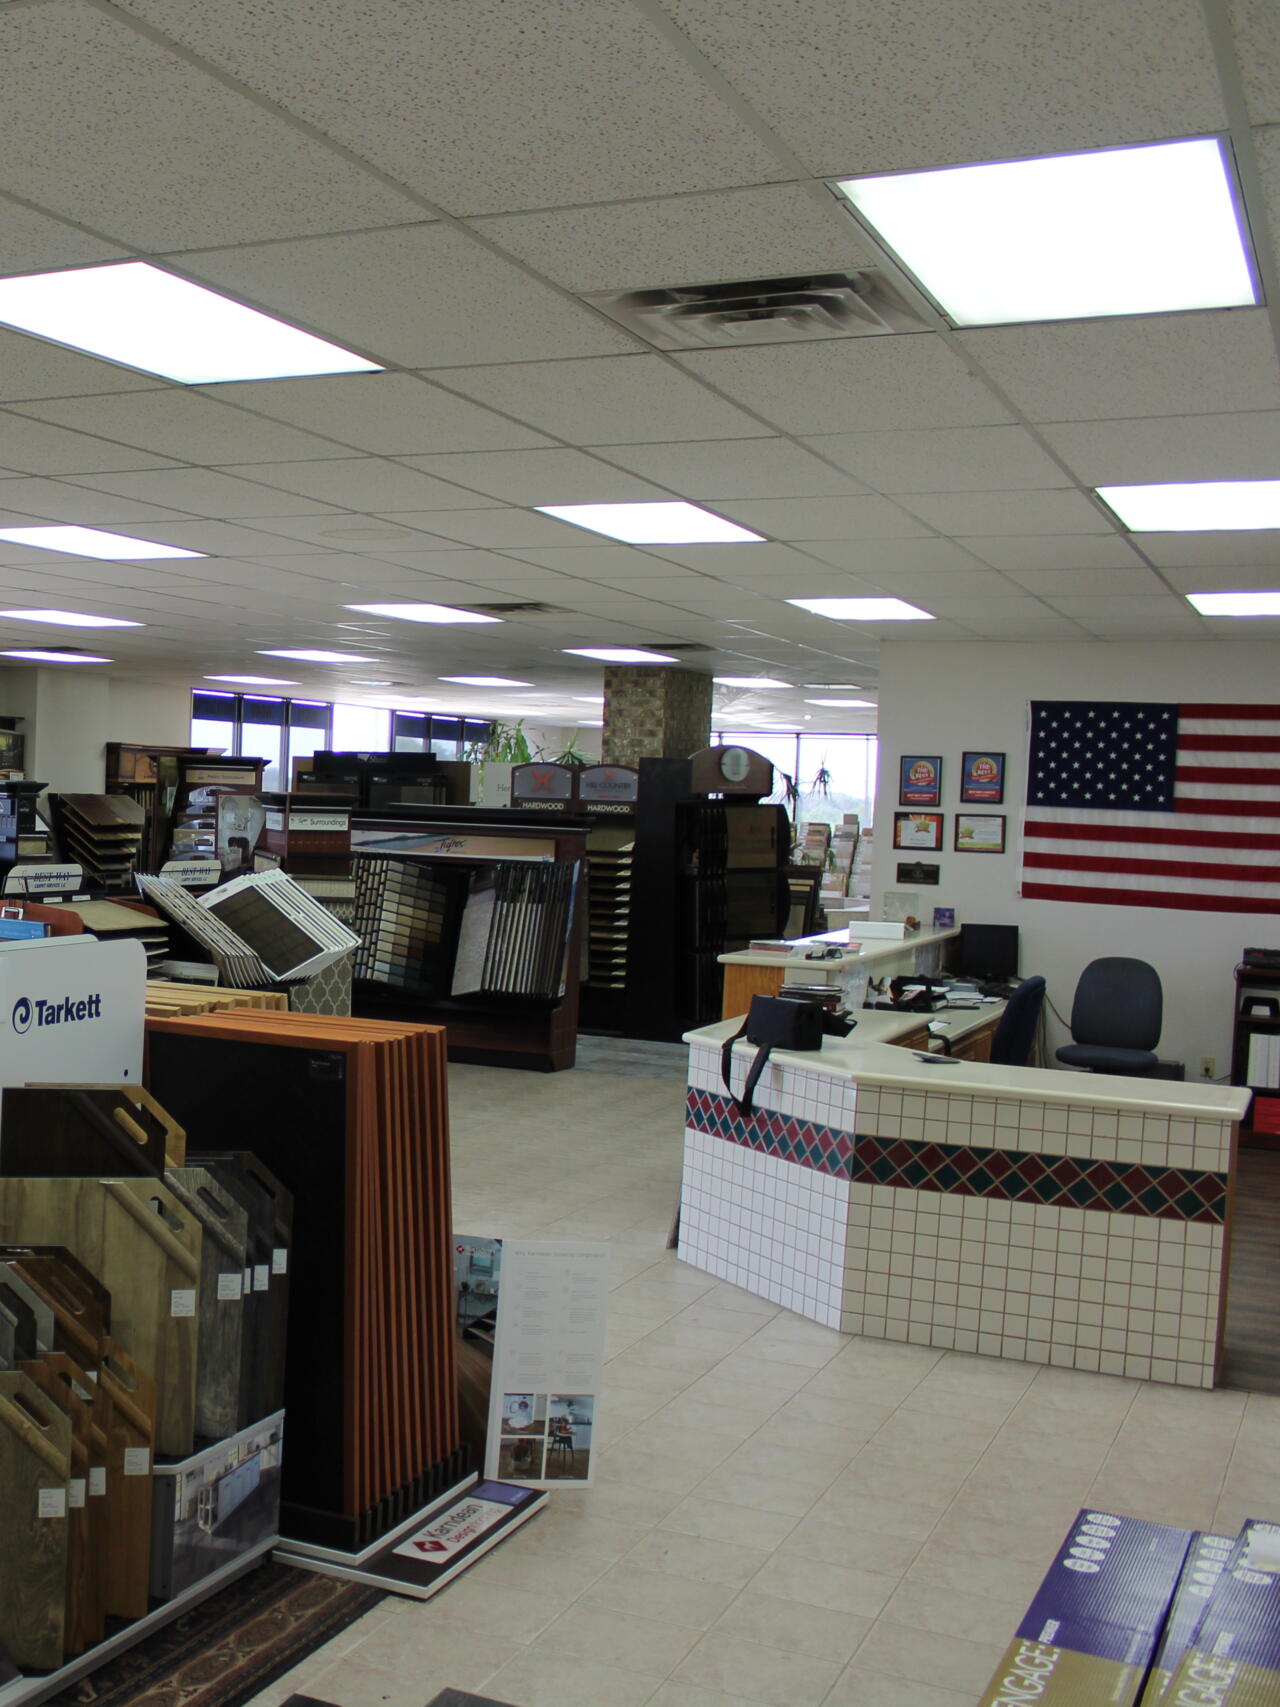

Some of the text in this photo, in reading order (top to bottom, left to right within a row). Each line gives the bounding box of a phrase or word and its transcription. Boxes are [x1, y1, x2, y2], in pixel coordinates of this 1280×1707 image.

[522, 801, 564, 811] HARDWOOD
[587, 804, 630, 813] HARDWOOD
[35, 994, 102, 1027] Tarkett
[423, 1504, 483, 1539] Karndean
